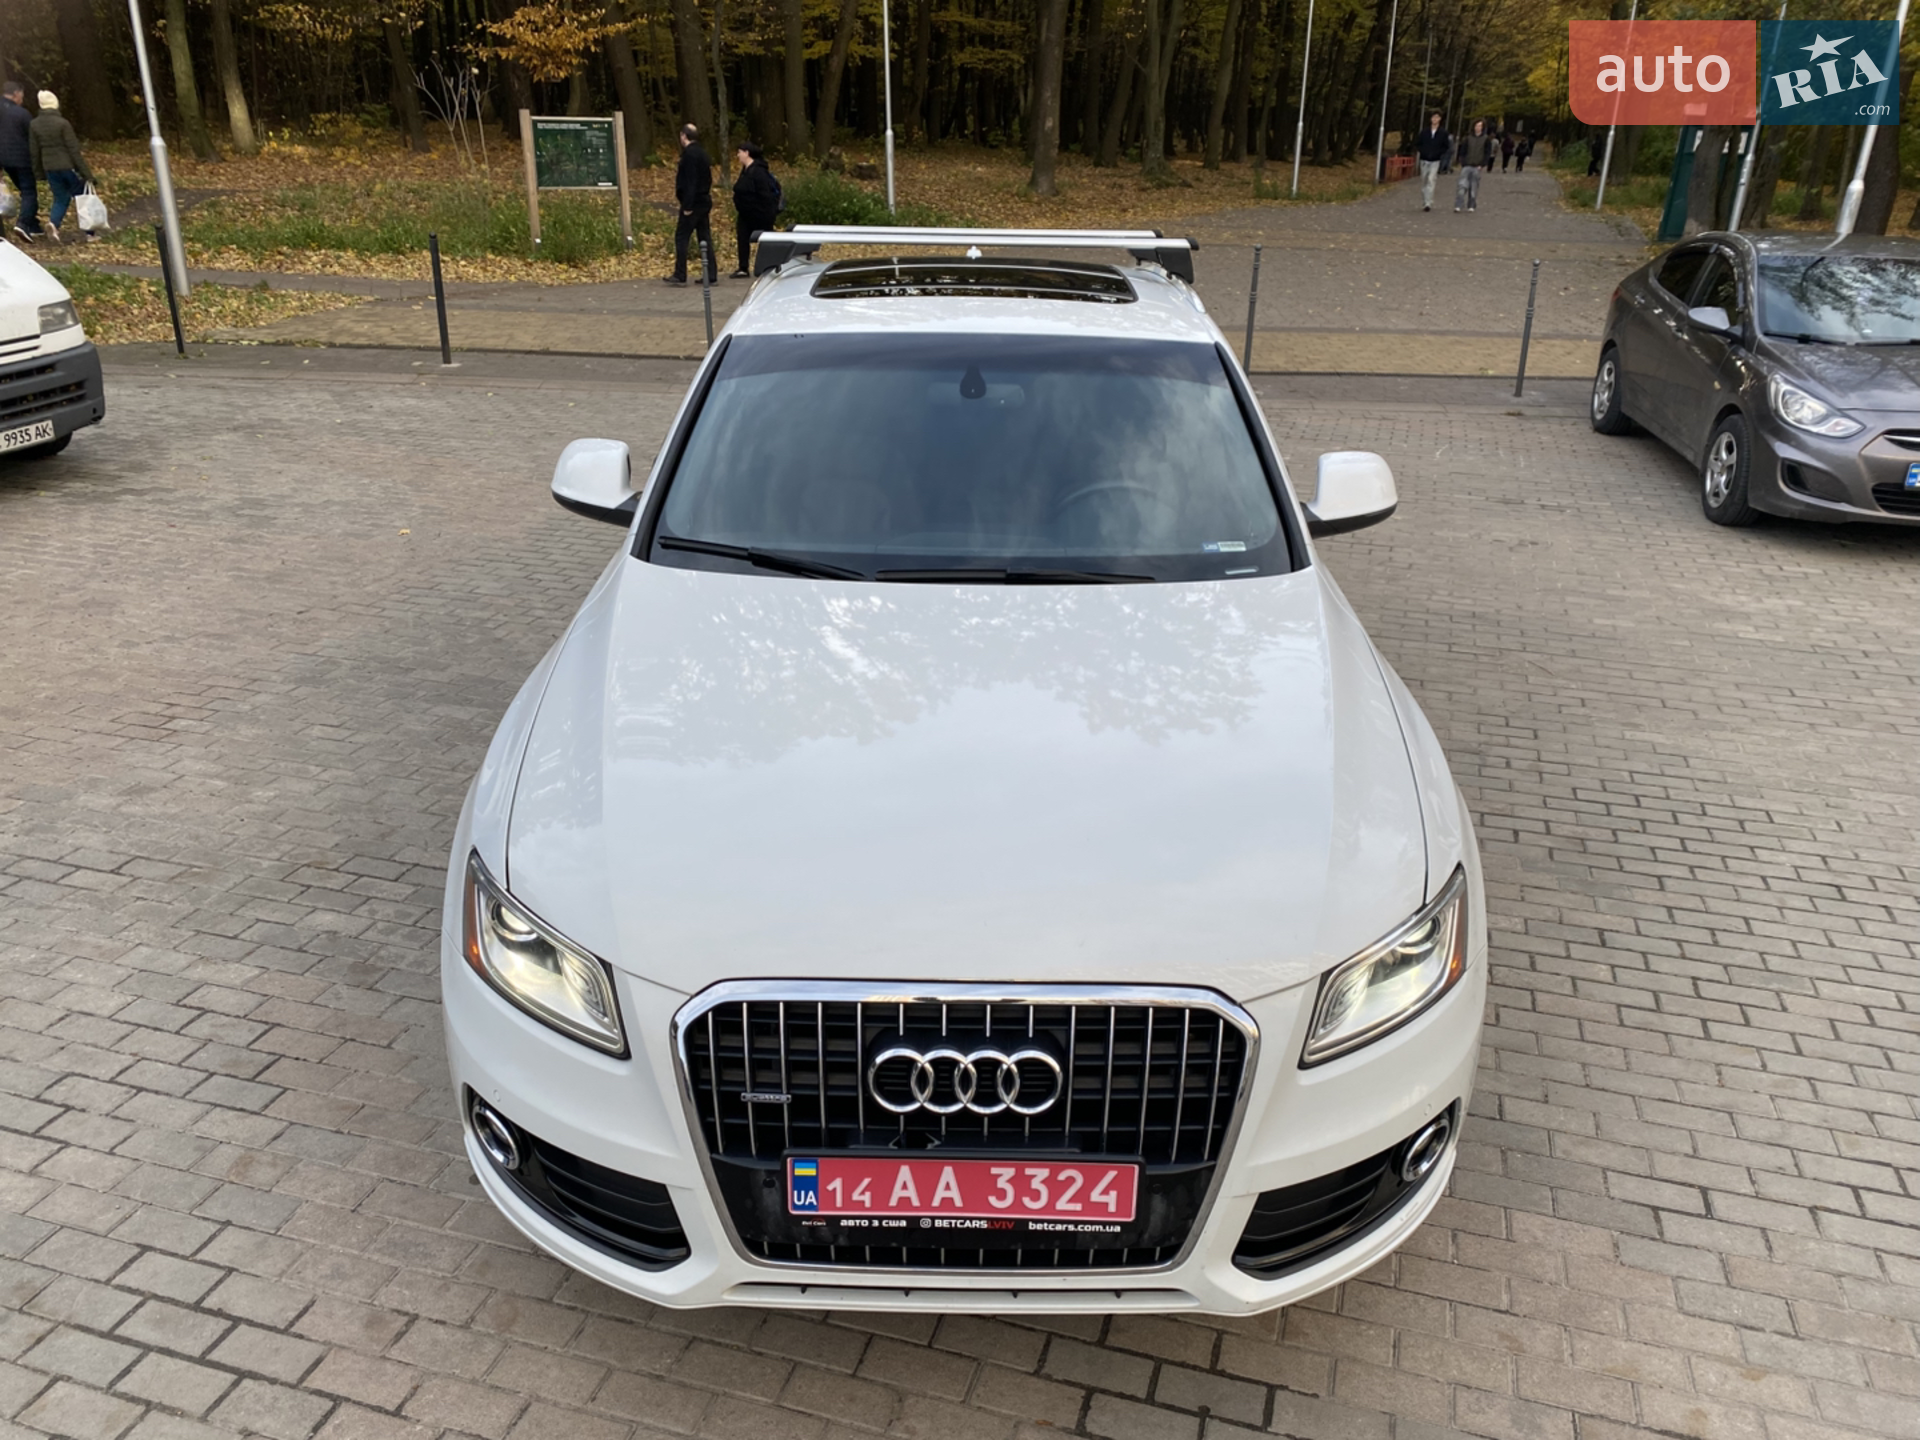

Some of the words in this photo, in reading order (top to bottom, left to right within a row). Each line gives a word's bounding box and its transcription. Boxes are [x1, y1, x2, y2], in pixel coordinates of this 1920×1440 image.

[4, 428, 32, 448] 9935
[35, 423, 51, 440] AK
[793, 1190, 817, 1206] UA
[825, 1177, 873, 1208] 14
[887, 1165, 964, 1208] AA
[987, 1166, 1118, 1213] 3324
[1029, 1221, 1121, 1232] betcars.com.ua
